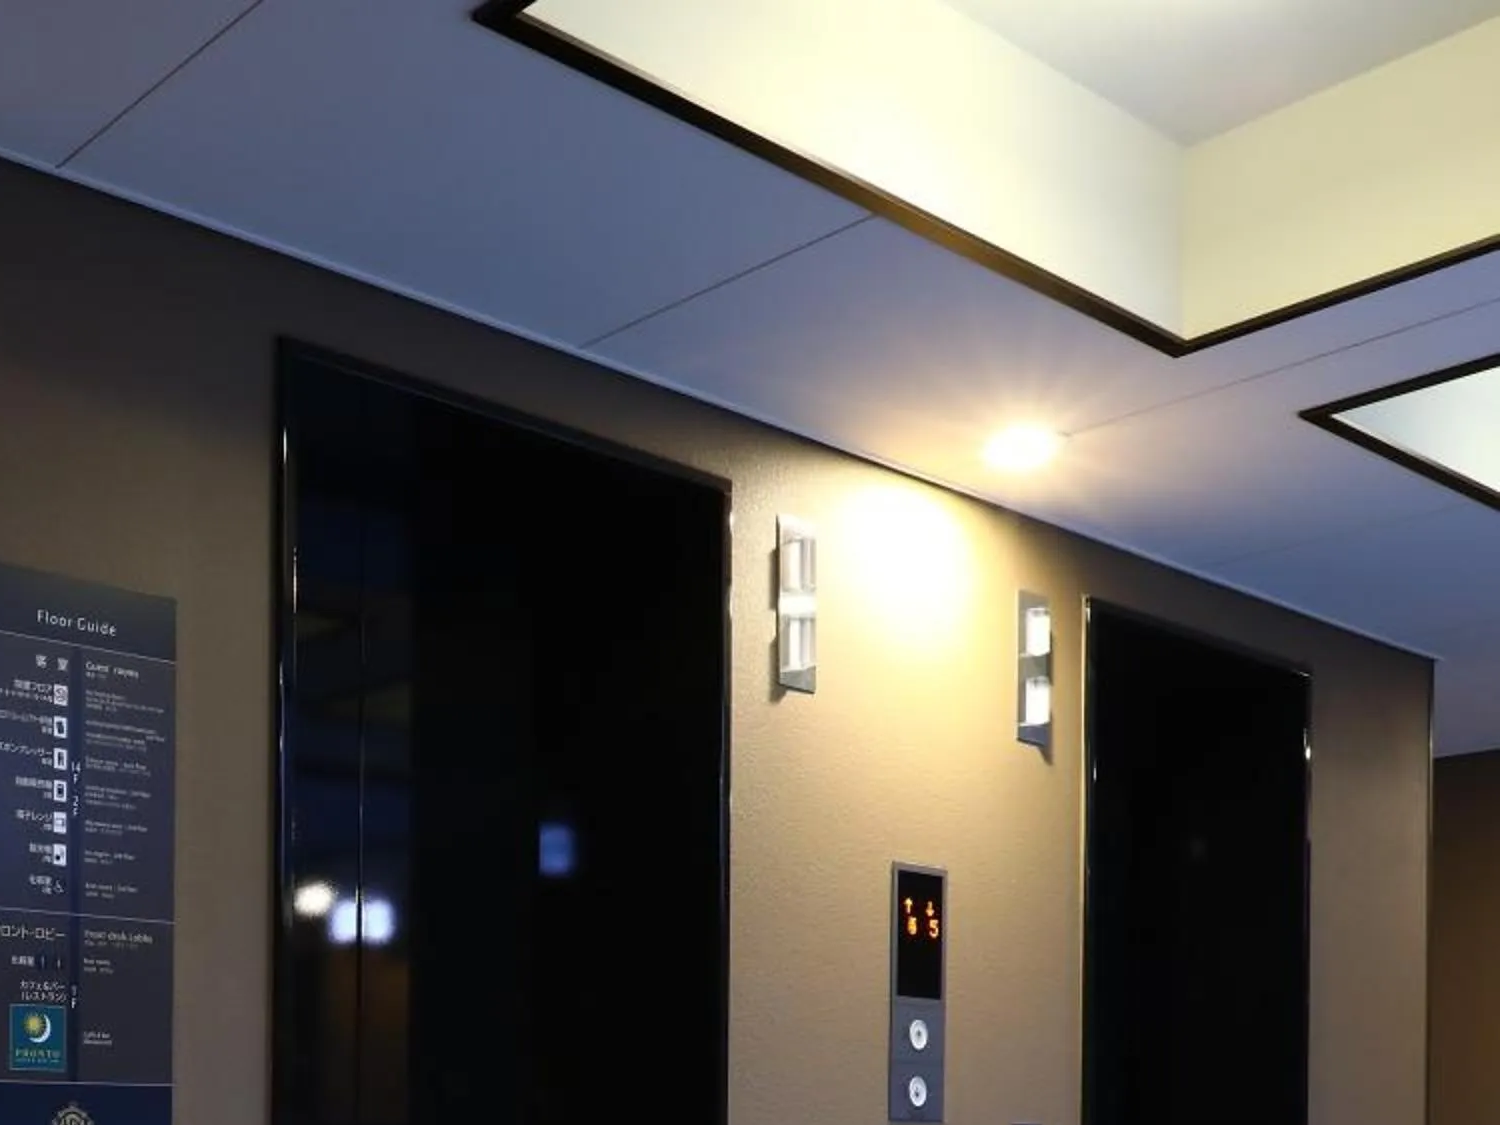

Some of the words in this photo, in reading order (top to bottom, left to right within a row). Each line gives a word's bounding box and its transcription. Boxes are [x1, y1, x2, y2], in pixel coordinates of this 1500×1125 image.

[37, 608, 72, 627] Floor
[76, 617, 117, 637] Guide
[929, 919, 939, 938] 5
